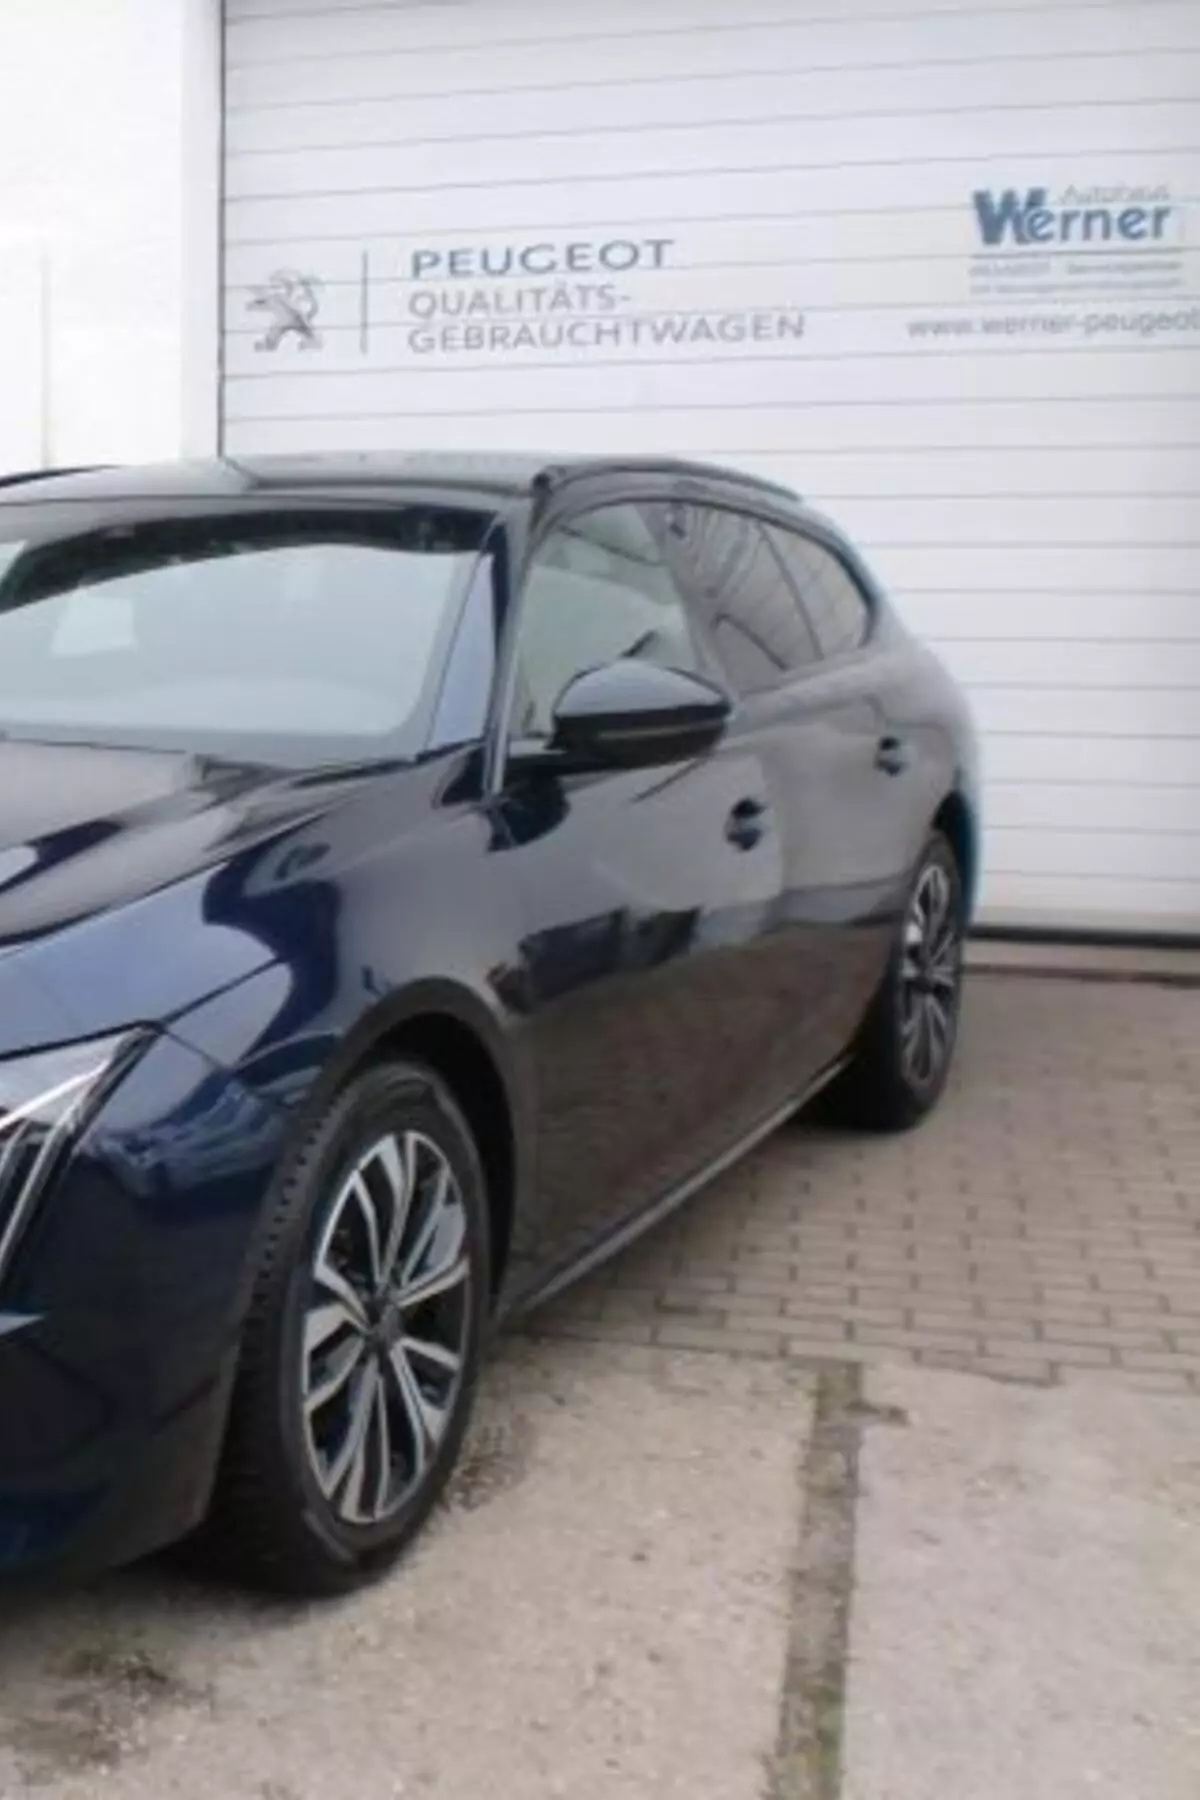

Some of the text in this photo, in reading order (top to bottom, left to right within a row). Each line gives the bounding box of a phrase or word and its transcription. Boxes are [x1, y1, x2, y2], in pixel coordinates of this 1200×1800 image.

[972, 186, 1172, 245] Werner
[410, 238, 675, 279] PEUGEOT
[406, 281, 631, 319] QUALITÄTS-
[406, 312, 806, 353] GEBRAUCHTWAGEN
